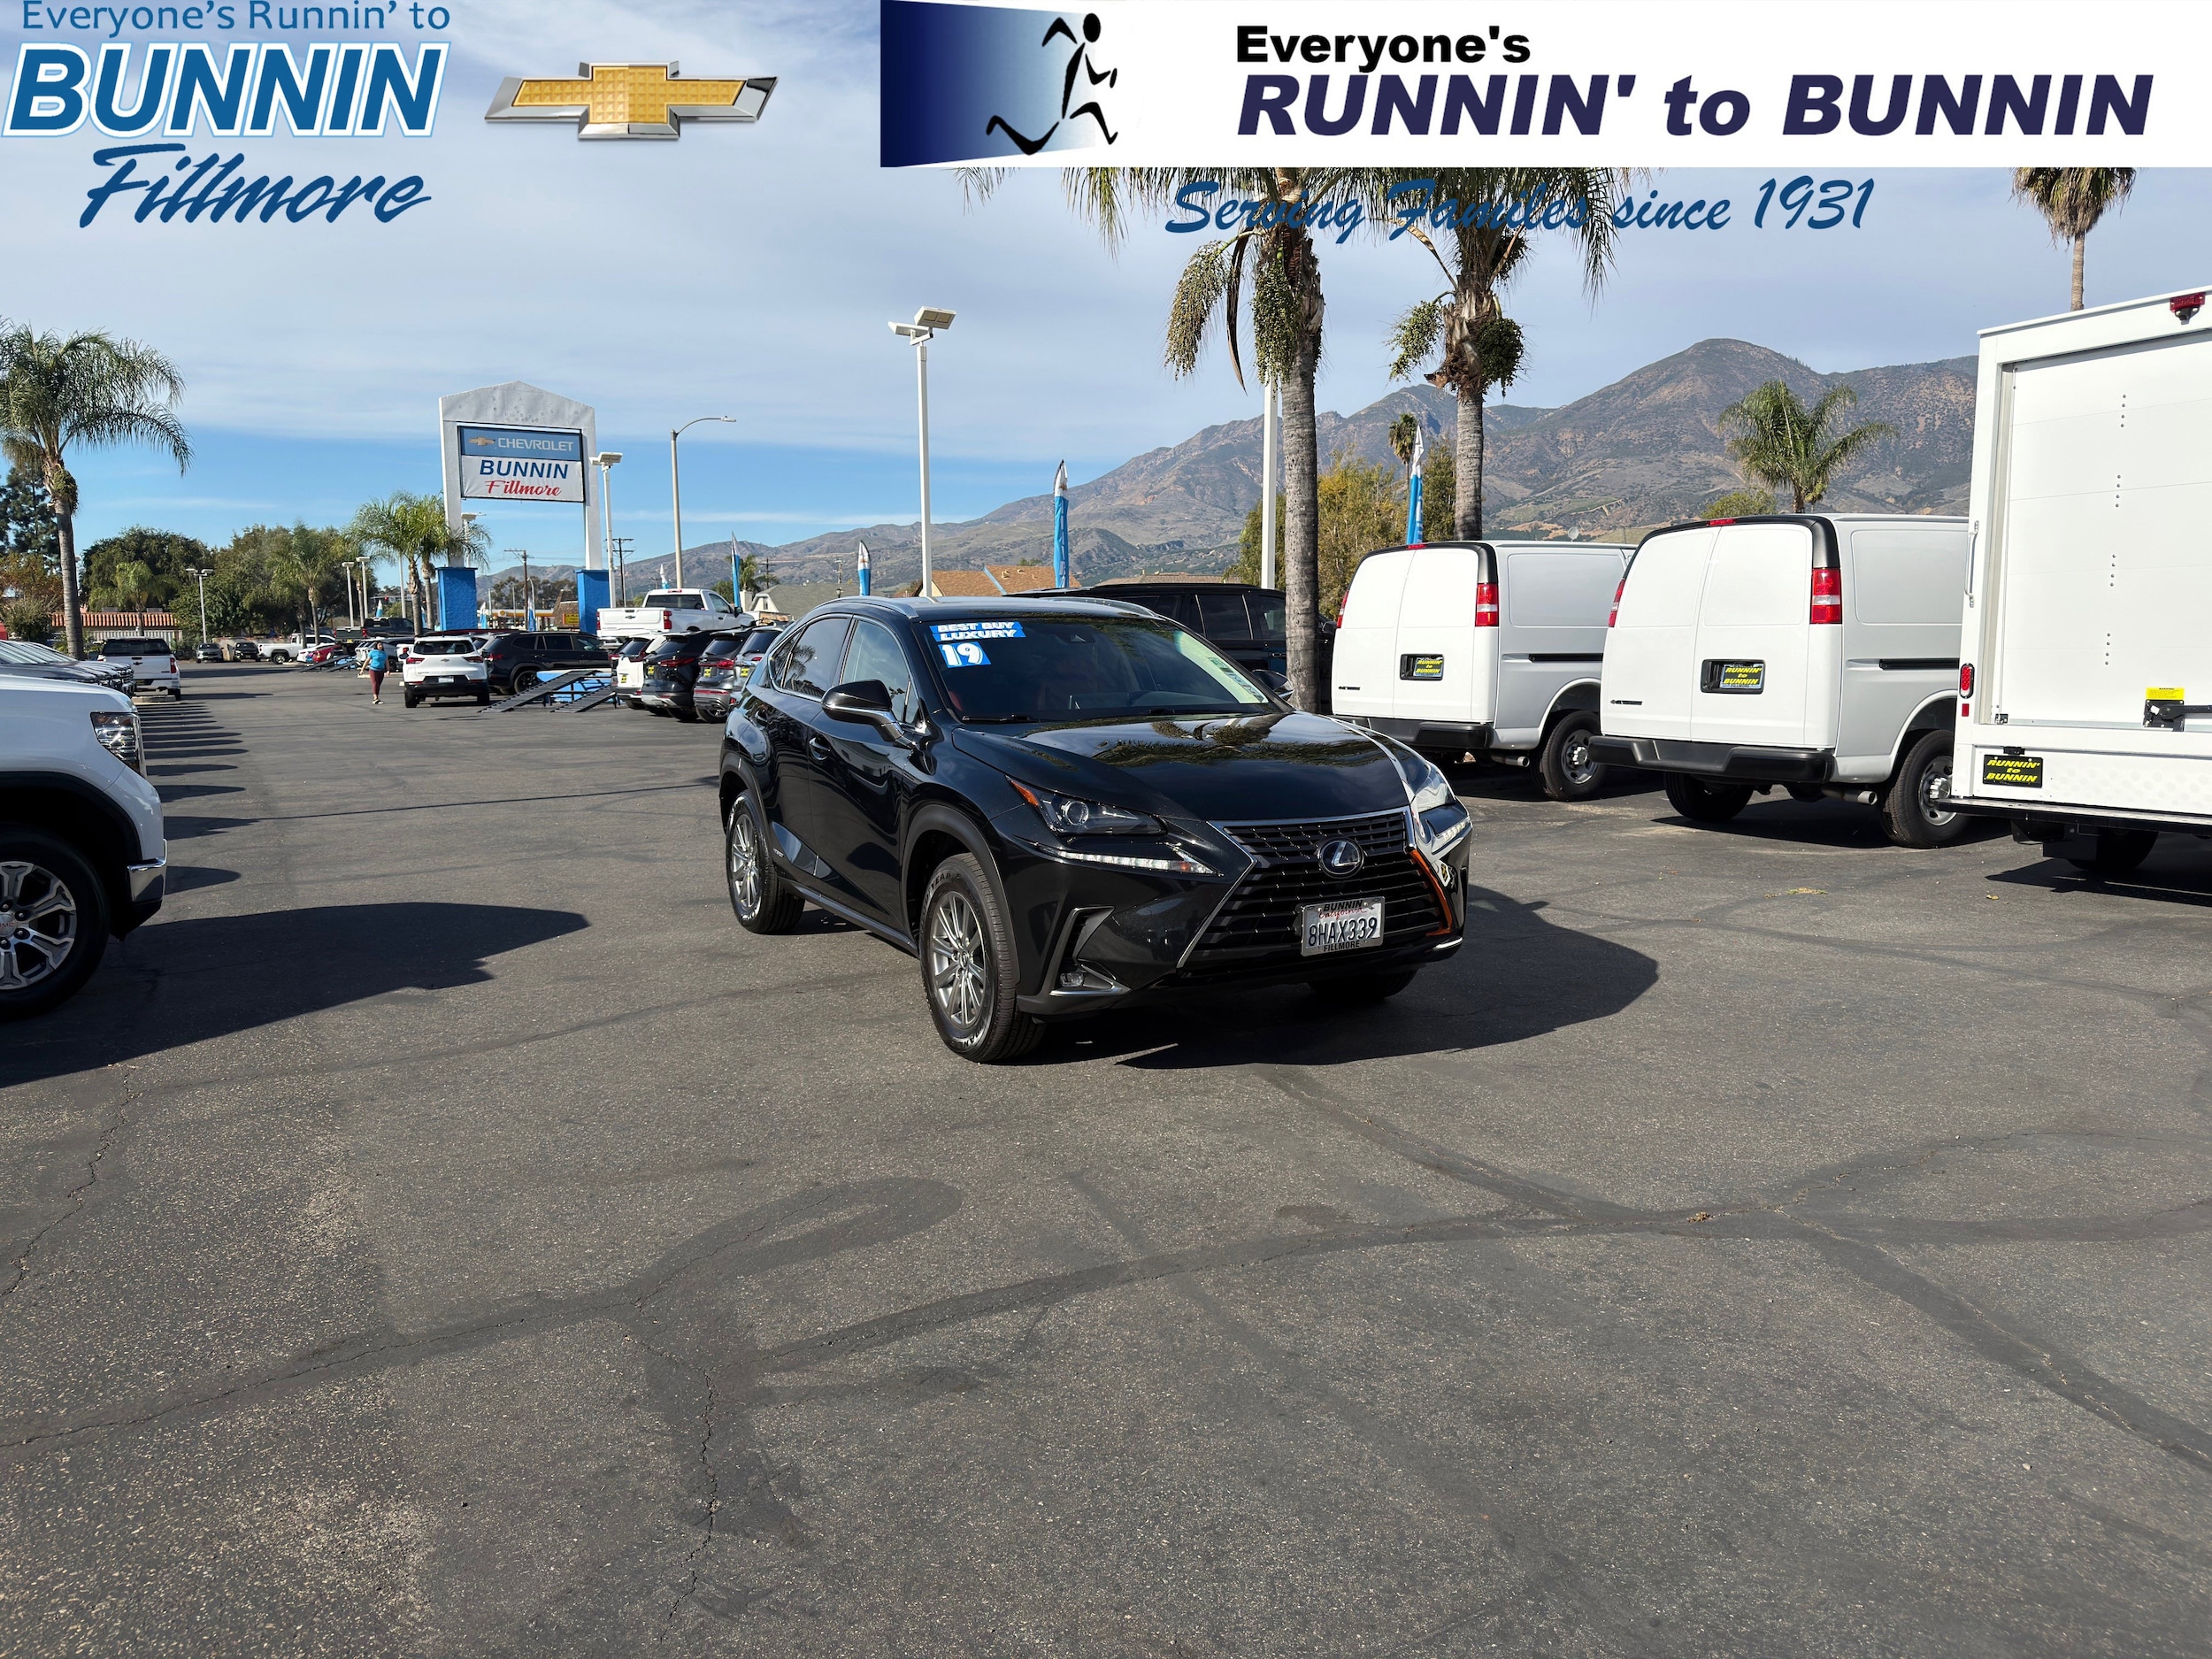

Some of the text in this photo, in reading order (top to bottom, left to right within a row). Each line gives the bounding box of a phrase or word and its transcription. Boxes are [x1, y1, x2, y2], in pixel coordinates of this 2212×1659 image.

[497, 437, 574, 452] CHEVROLET
[479, 459, 569, 479] BUNNIN
[485, 480, 563, 496] Fillmore
[937, 621, 1015, 633] BEST BUY
[940, 629, 1018, 641] LUXURY
[942, 642, 983, 666] 19
[1986, 759, 2040, 769] RUNNIN'
[1985, 772, 2038, 782] BUNNIN
[1323, 900, 1363, 912] BUNNIN
[1308, 917, 1378, 947] 8HAX339
[1323, 940, 1360, 953] FILLMORE
